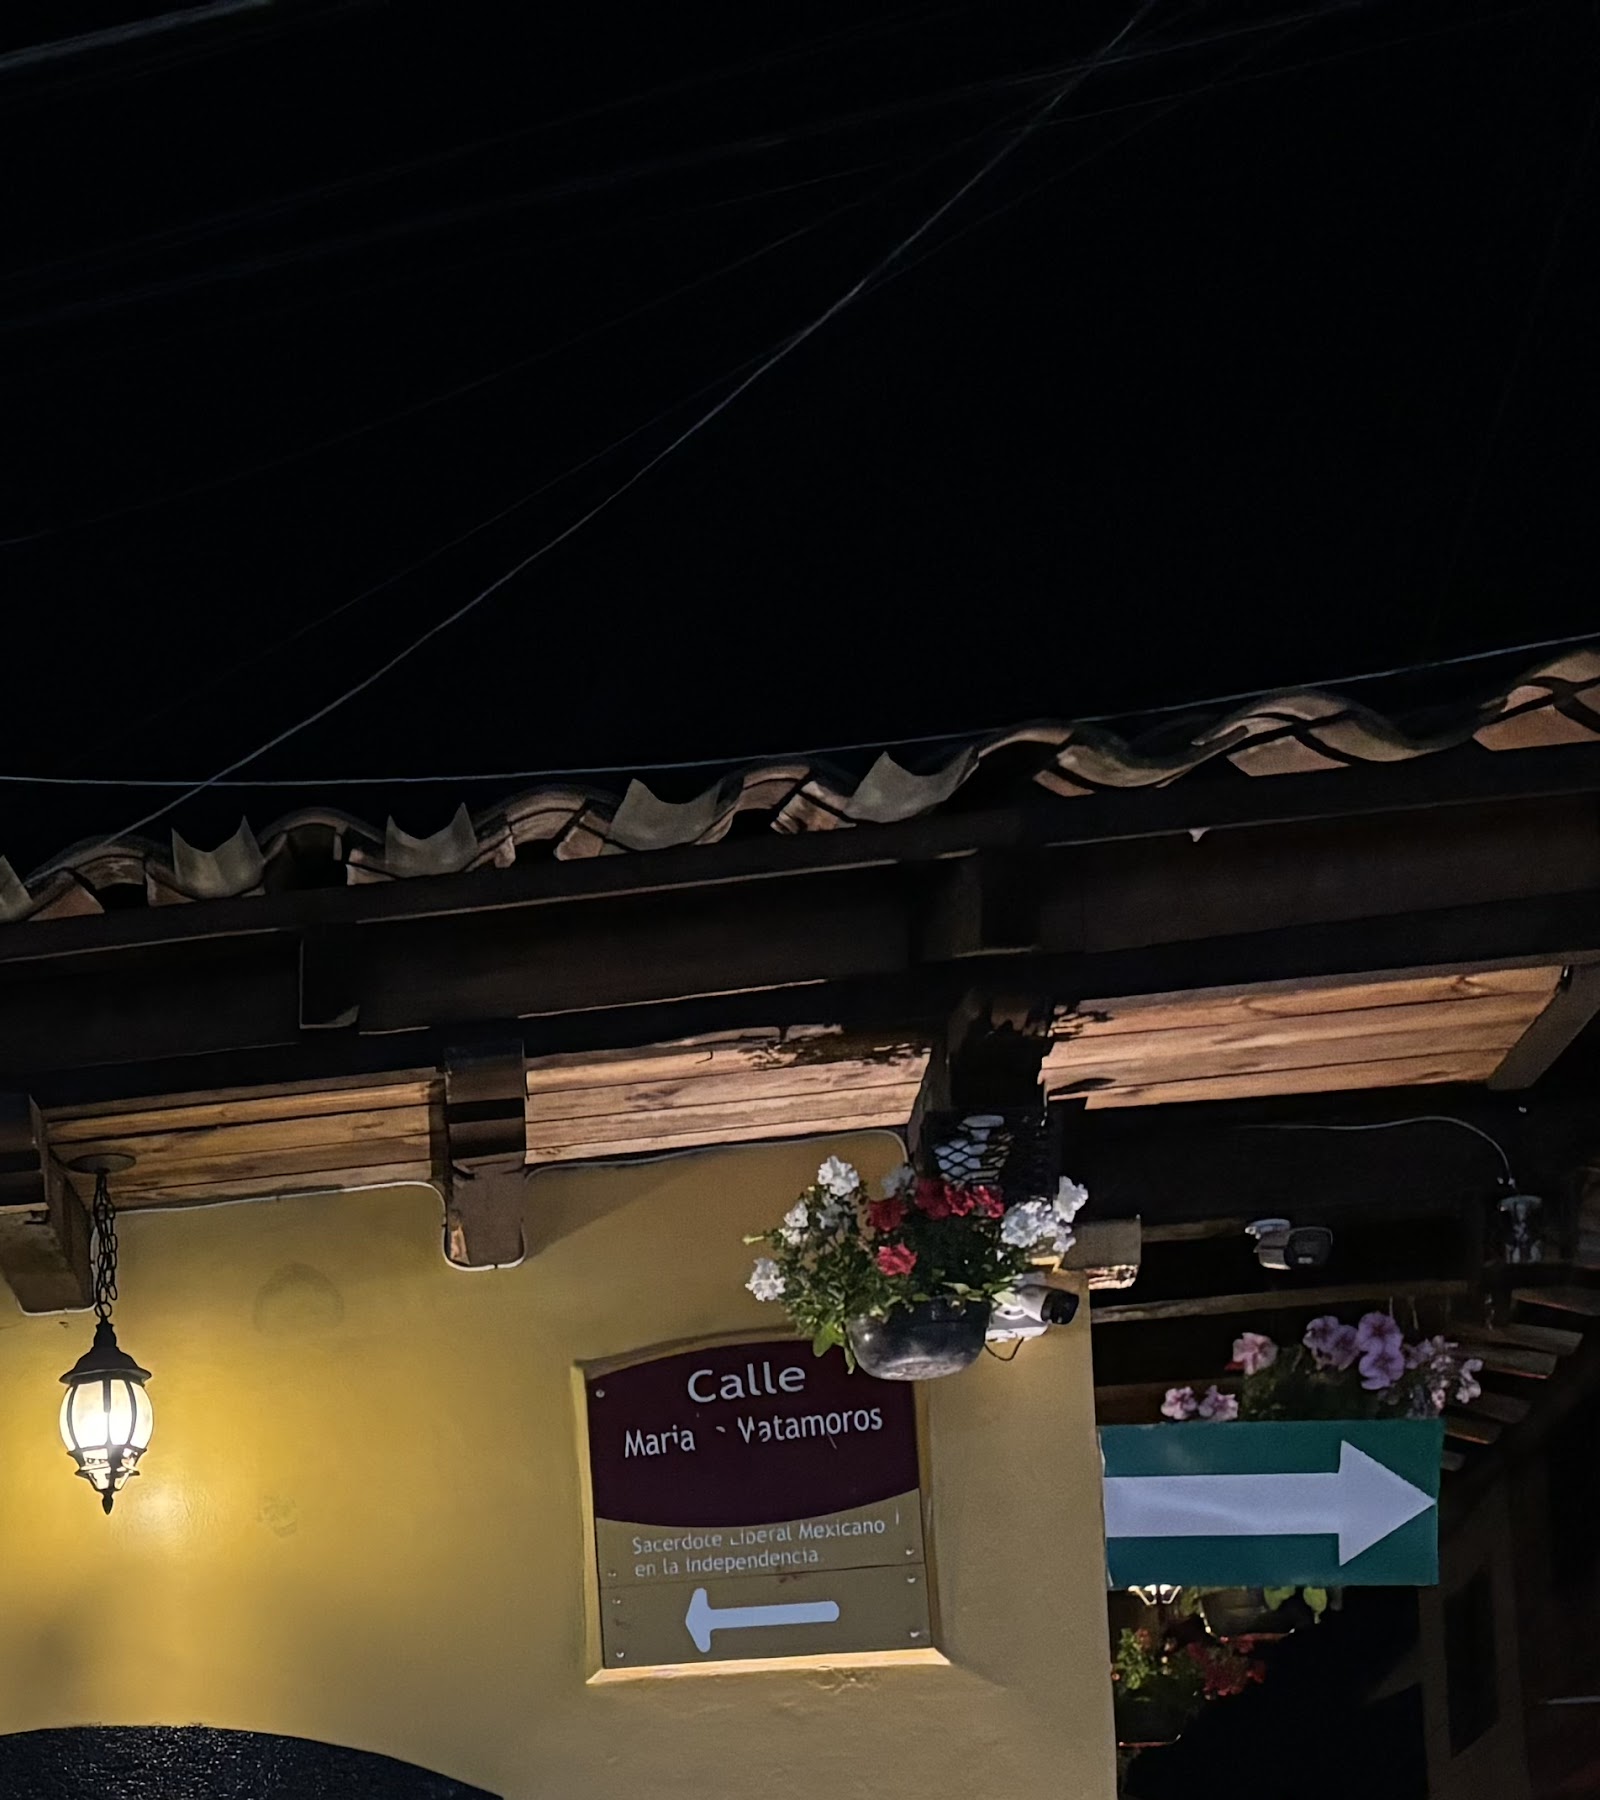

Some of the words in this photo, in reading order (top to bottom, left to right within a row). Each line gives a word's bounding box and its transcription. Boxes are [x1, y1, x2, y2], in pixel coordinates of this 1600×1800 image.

[687, 1361, 806, 1403] Calle
[632, 1533, 722, 1555] Sacerdote
[799, 1518, 885, 1539] Mexicano
[634, 1562, 656, 1577] en
[663, 1558, 679, 1574] la
[686, 1547, 819, 1573] Independencia
